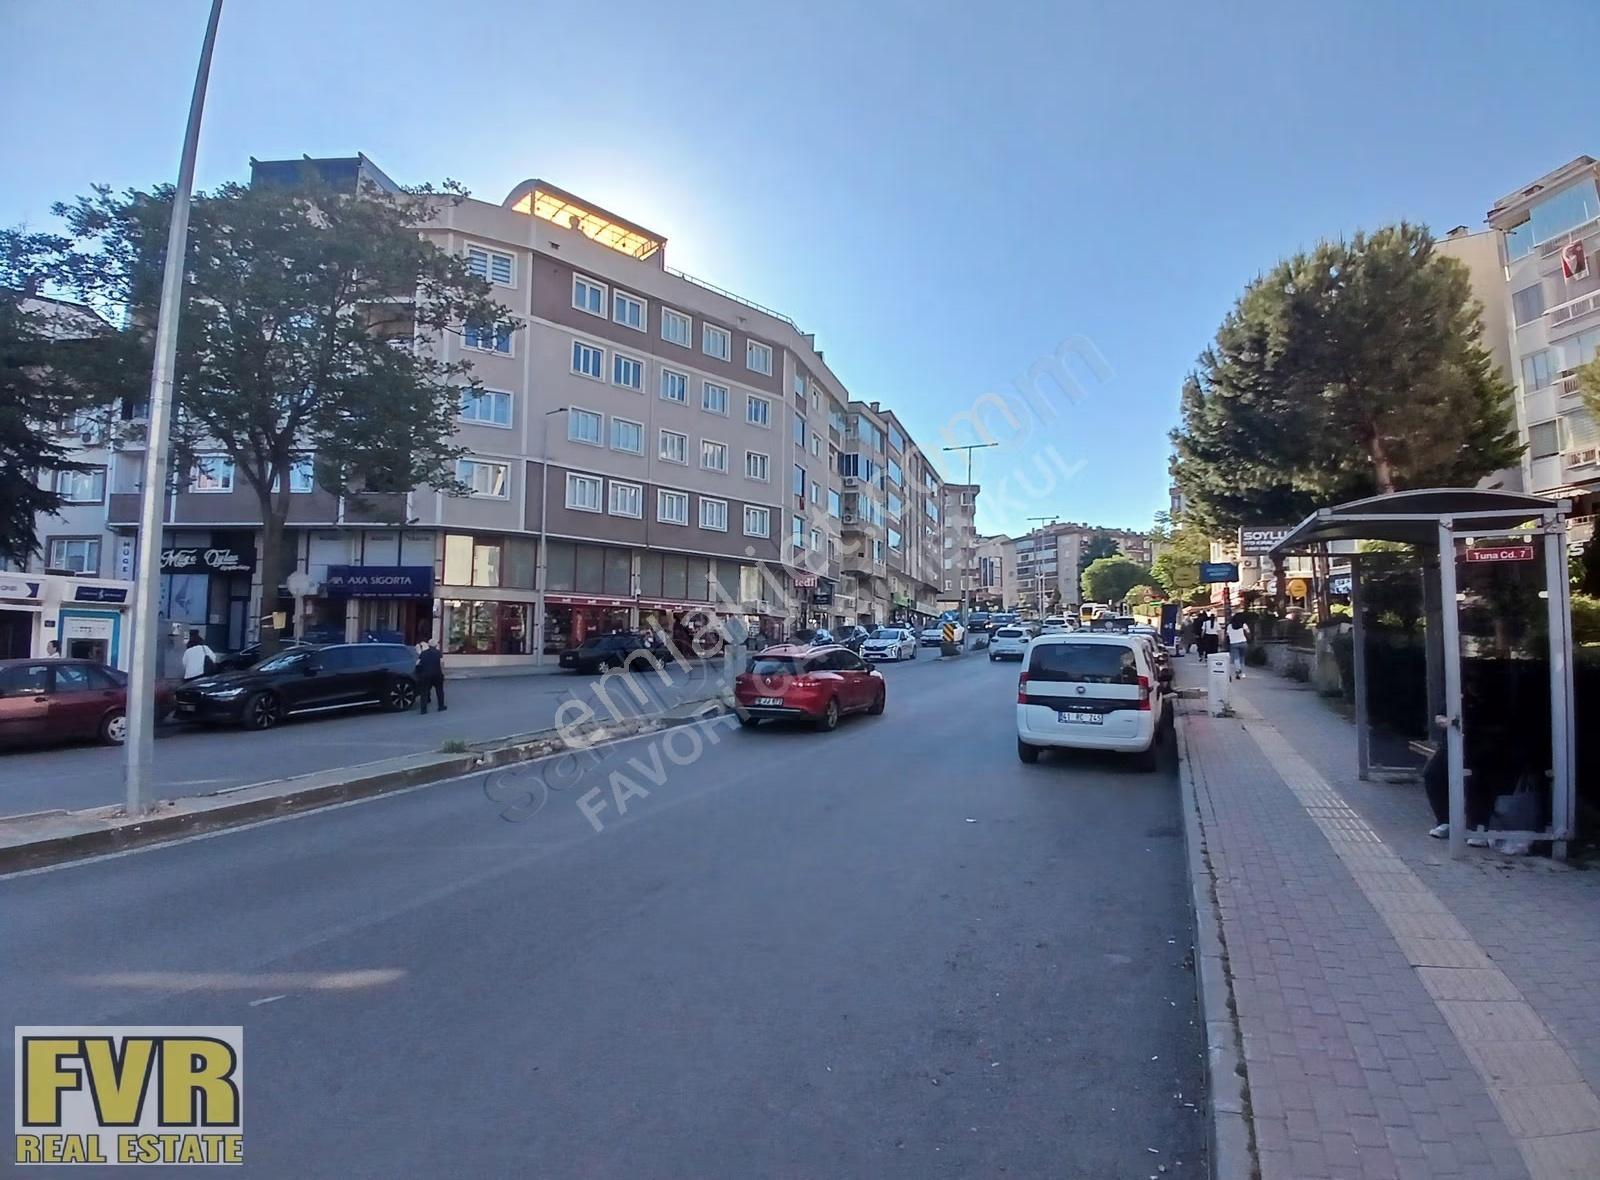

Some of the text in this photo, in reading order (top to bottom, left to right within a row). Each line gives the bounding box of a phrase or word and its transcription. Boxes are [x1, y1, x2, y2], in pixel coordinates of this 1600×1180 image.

[1243, 531, 1288, 540] SOYLU
[1474, 550, 1526, 560] Tuna Cd. 7
[347, 576, 369, 585] AXA
